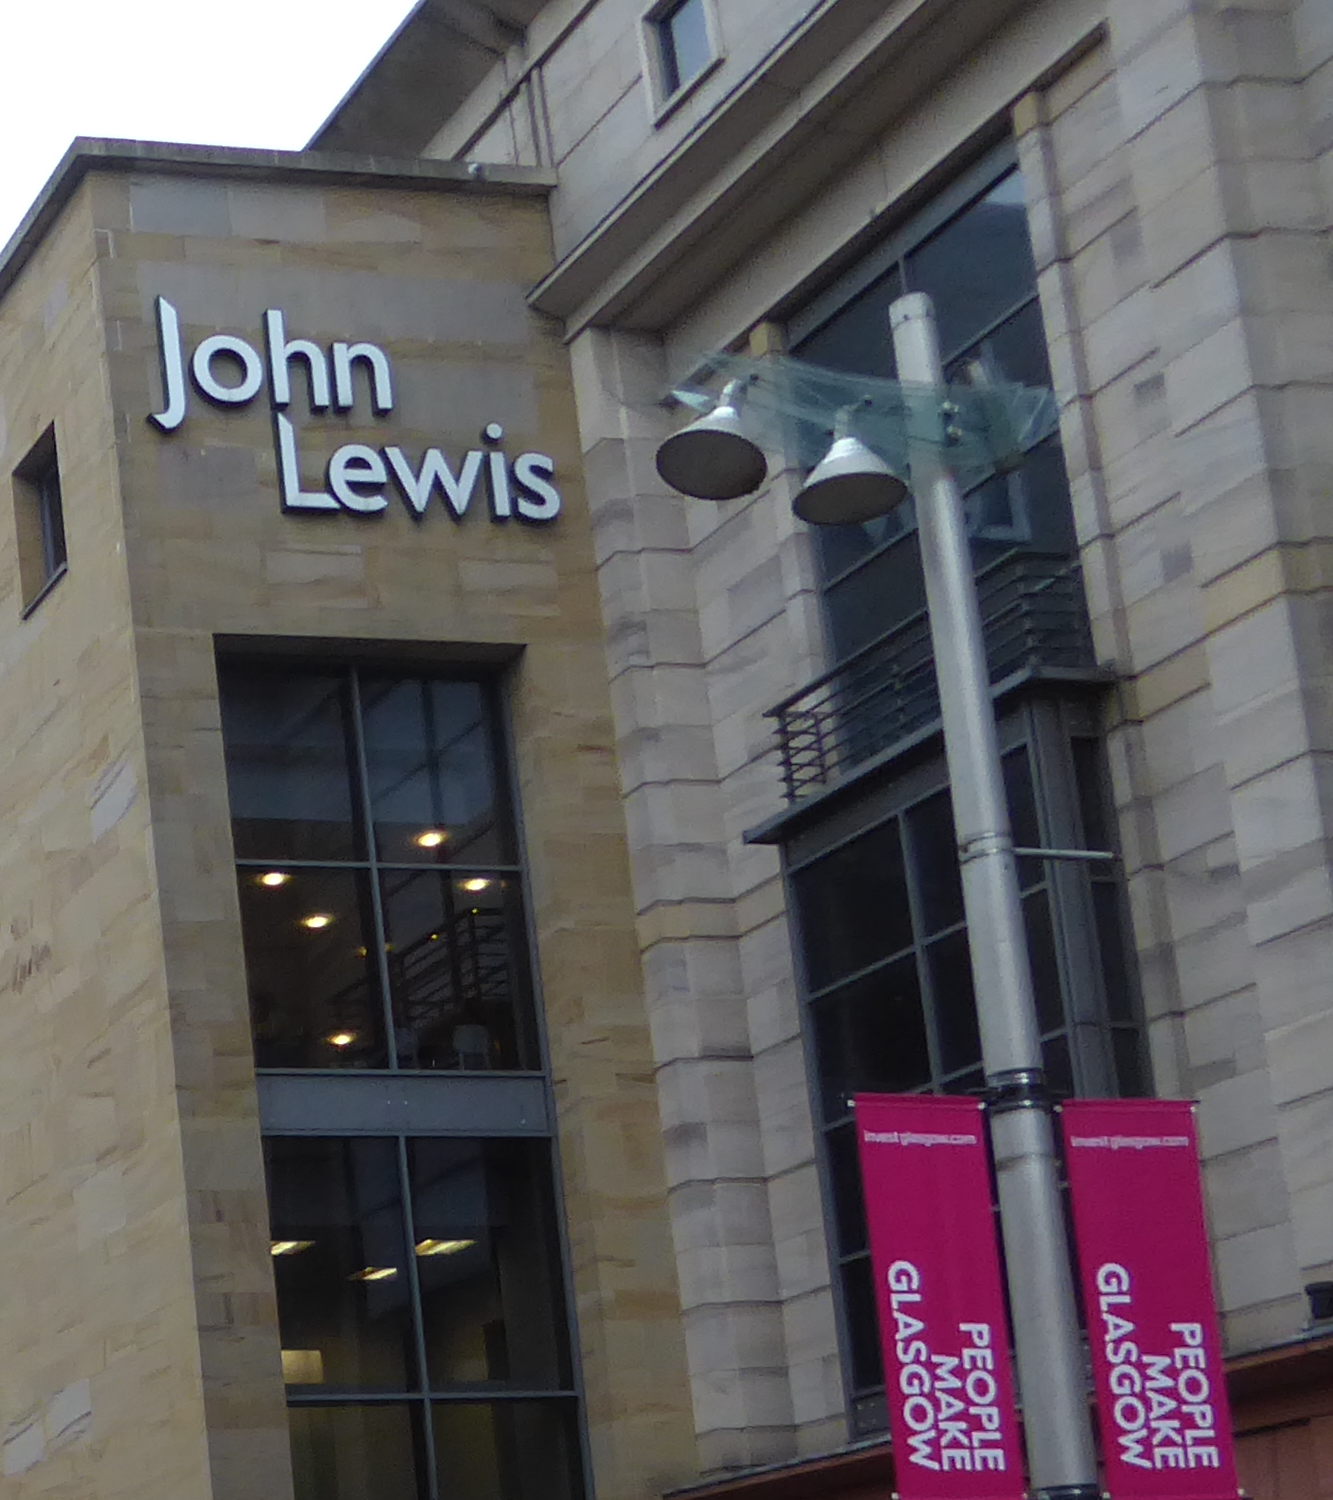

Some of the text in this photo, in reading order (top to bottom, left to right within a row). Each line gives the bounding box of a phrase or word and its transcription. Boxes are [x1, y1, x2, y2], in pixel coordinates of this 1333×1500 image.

[148, 294, 394, 435] John
[275, 411, 562, 524] Lewis
[886, 1259, 940, 1472] GLASGOW
[931, 1353, 973, 1472] MAKE
[958, 1321, 1006, 1472] PEOPLE
[1096, 1261, 1153, 1470] GLASGOW
[1141, 1354, 1185, 1470] MAKE
[1170, 1321, 1220, 1469] PEOPLE
